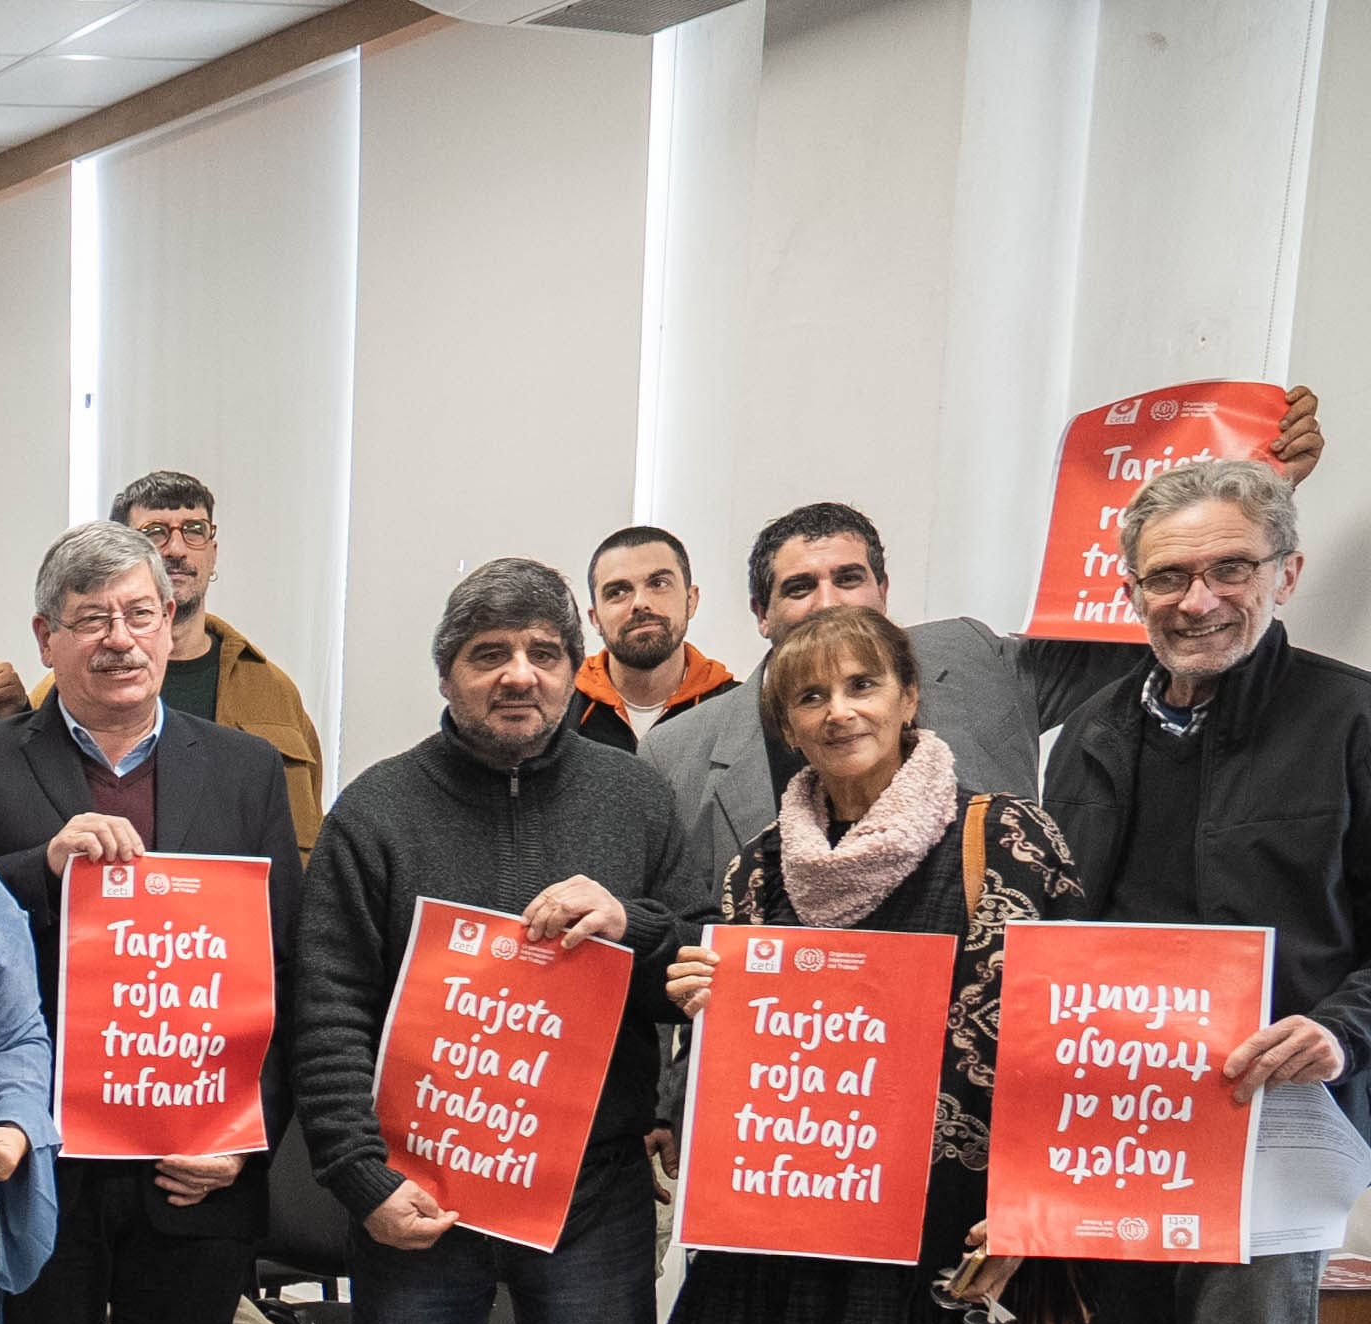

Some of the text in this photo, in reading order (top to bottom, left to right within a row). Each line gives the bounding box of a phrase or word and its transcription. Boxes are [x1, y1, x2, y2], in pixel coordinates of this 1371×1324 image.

[106, 919, 228, 969] Tarjeta
[112, 969, 222, 1019] roja al
[443, 975, 563, 1044] Tarjeta
[1049, 982, 1212, 1031] infantil
[100, 1020, 226, 1068] trabajo
[747, 996, 886, 1051] Tarjeta
[431, 1033, 550, 1088] roja al
[749, 1051, 878, 1103] roja al
[1055, 1026, 1212, 1082] trabajo
[102, 1066, 226, 1107] infantil
[415, 1073, 539, 1143] trabajo
[1057, 1084, 1193, 1135] roja al
[406, 1120, 538, 1189] infantil
[733, 1102, 878, 1160] trabajo
[731, 1153, 882, 1204] infantil
[1048, 1135, 1195, 1191] Tarjeta
